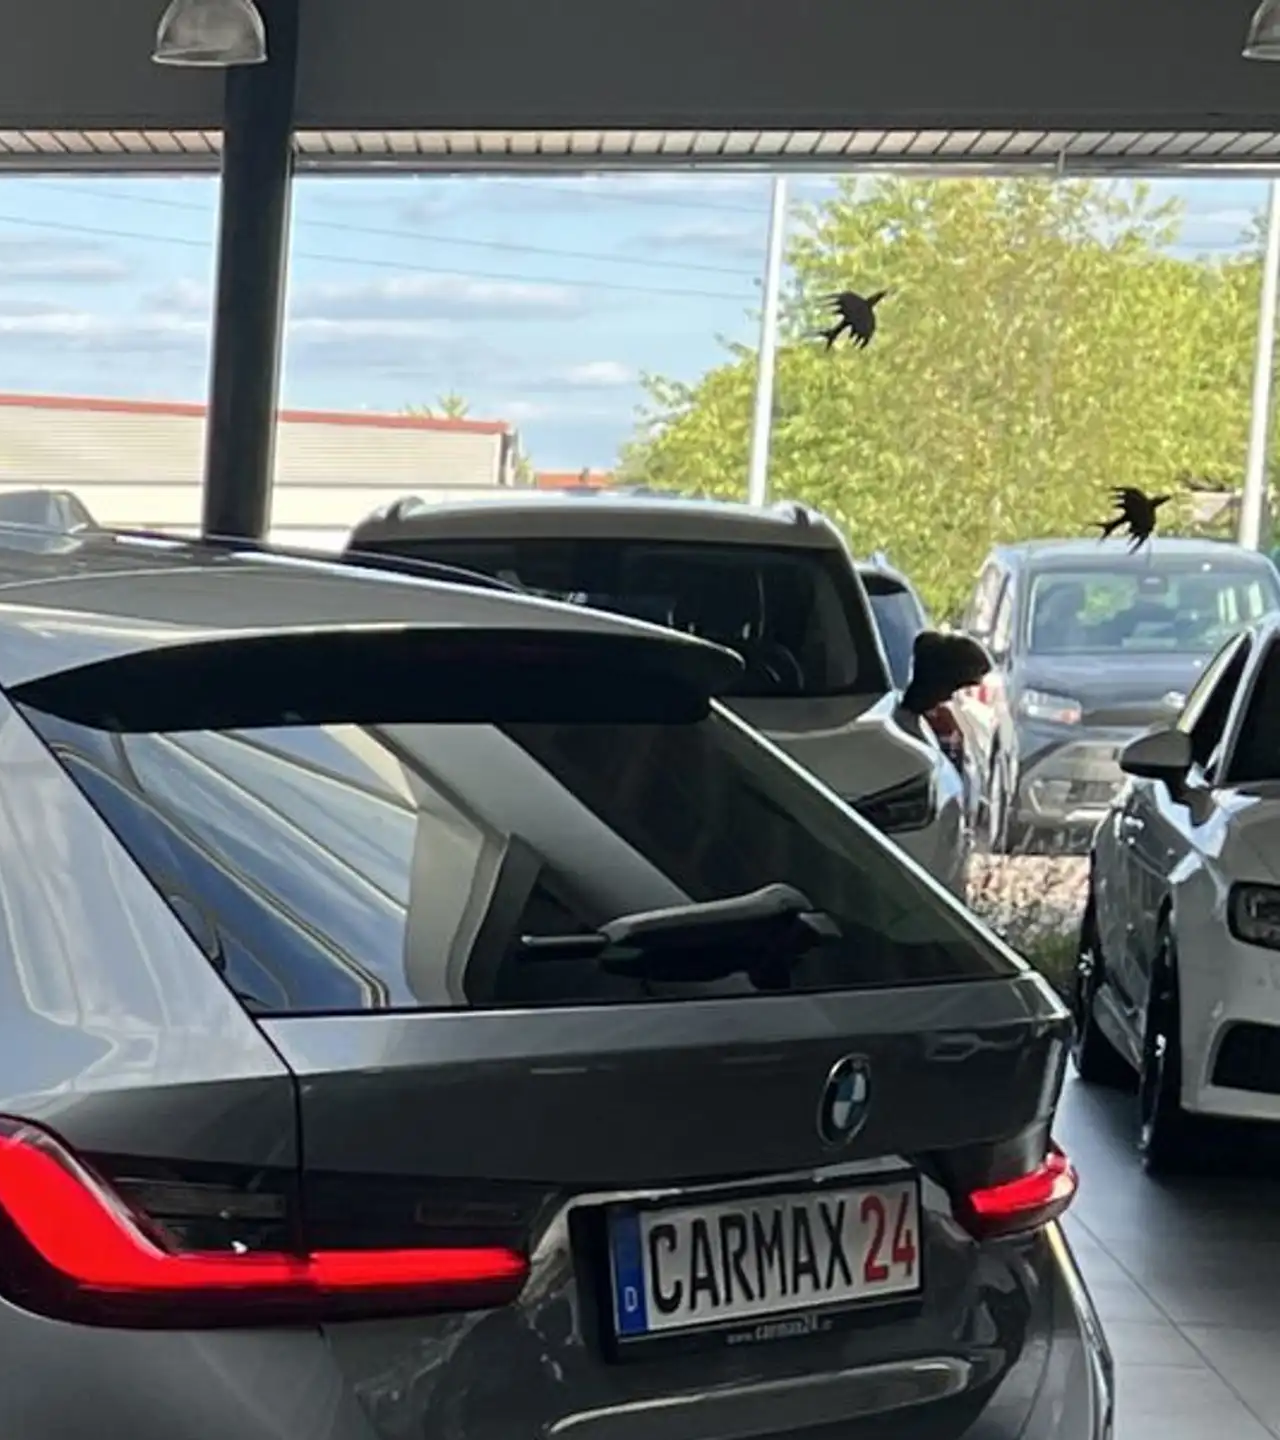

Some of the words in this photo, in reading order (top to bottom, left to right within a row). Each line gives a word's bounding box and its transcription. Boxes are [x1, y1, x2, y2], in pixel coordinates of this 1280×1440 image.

[648, 1201, 852, 1314] CARMAX
[860, 1192, 917, 1283] 24
[624, 1286, 639, 1312] D
